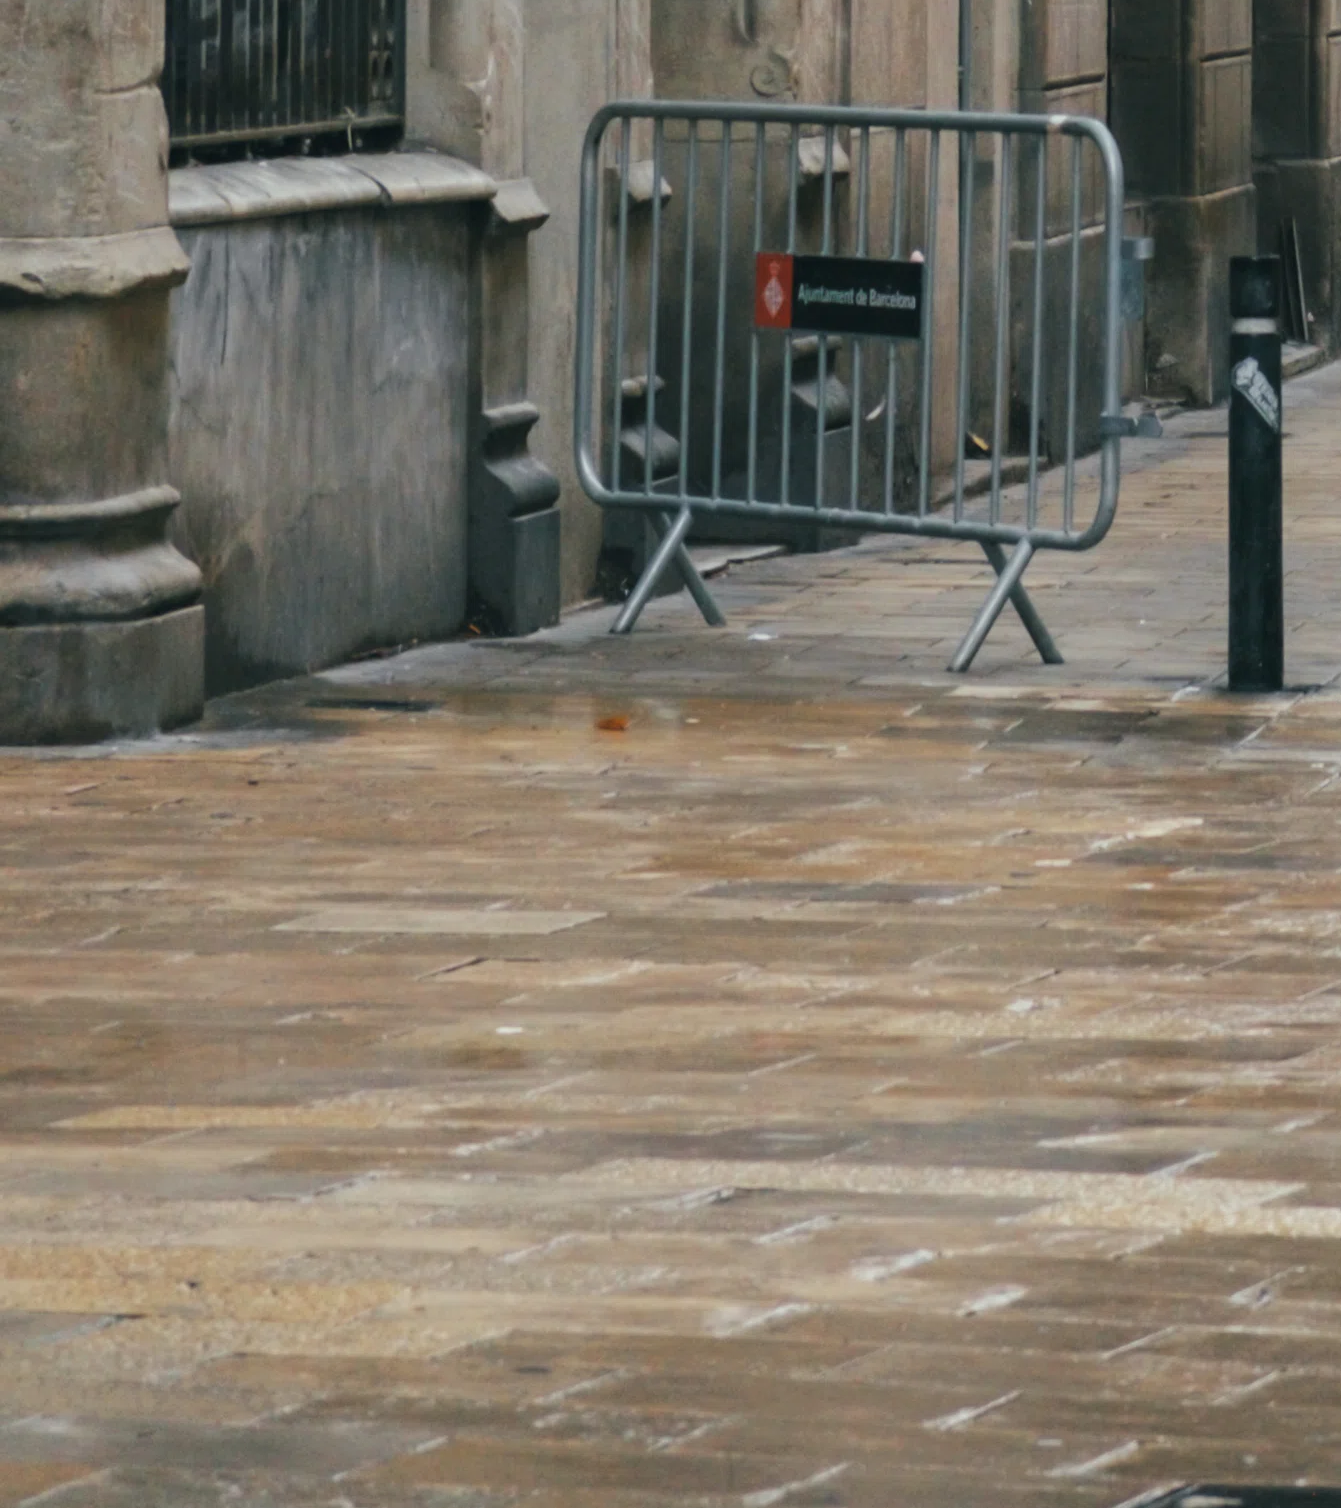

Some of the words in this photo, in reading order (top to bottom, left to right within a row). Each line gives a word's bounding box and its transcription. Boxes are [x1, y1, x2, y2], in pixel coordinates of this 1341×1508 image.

[798, 283, 855, 305] Ajuntament
[856, 288, 868, 307] de
[869, 288, 917, 310] Barcelona
